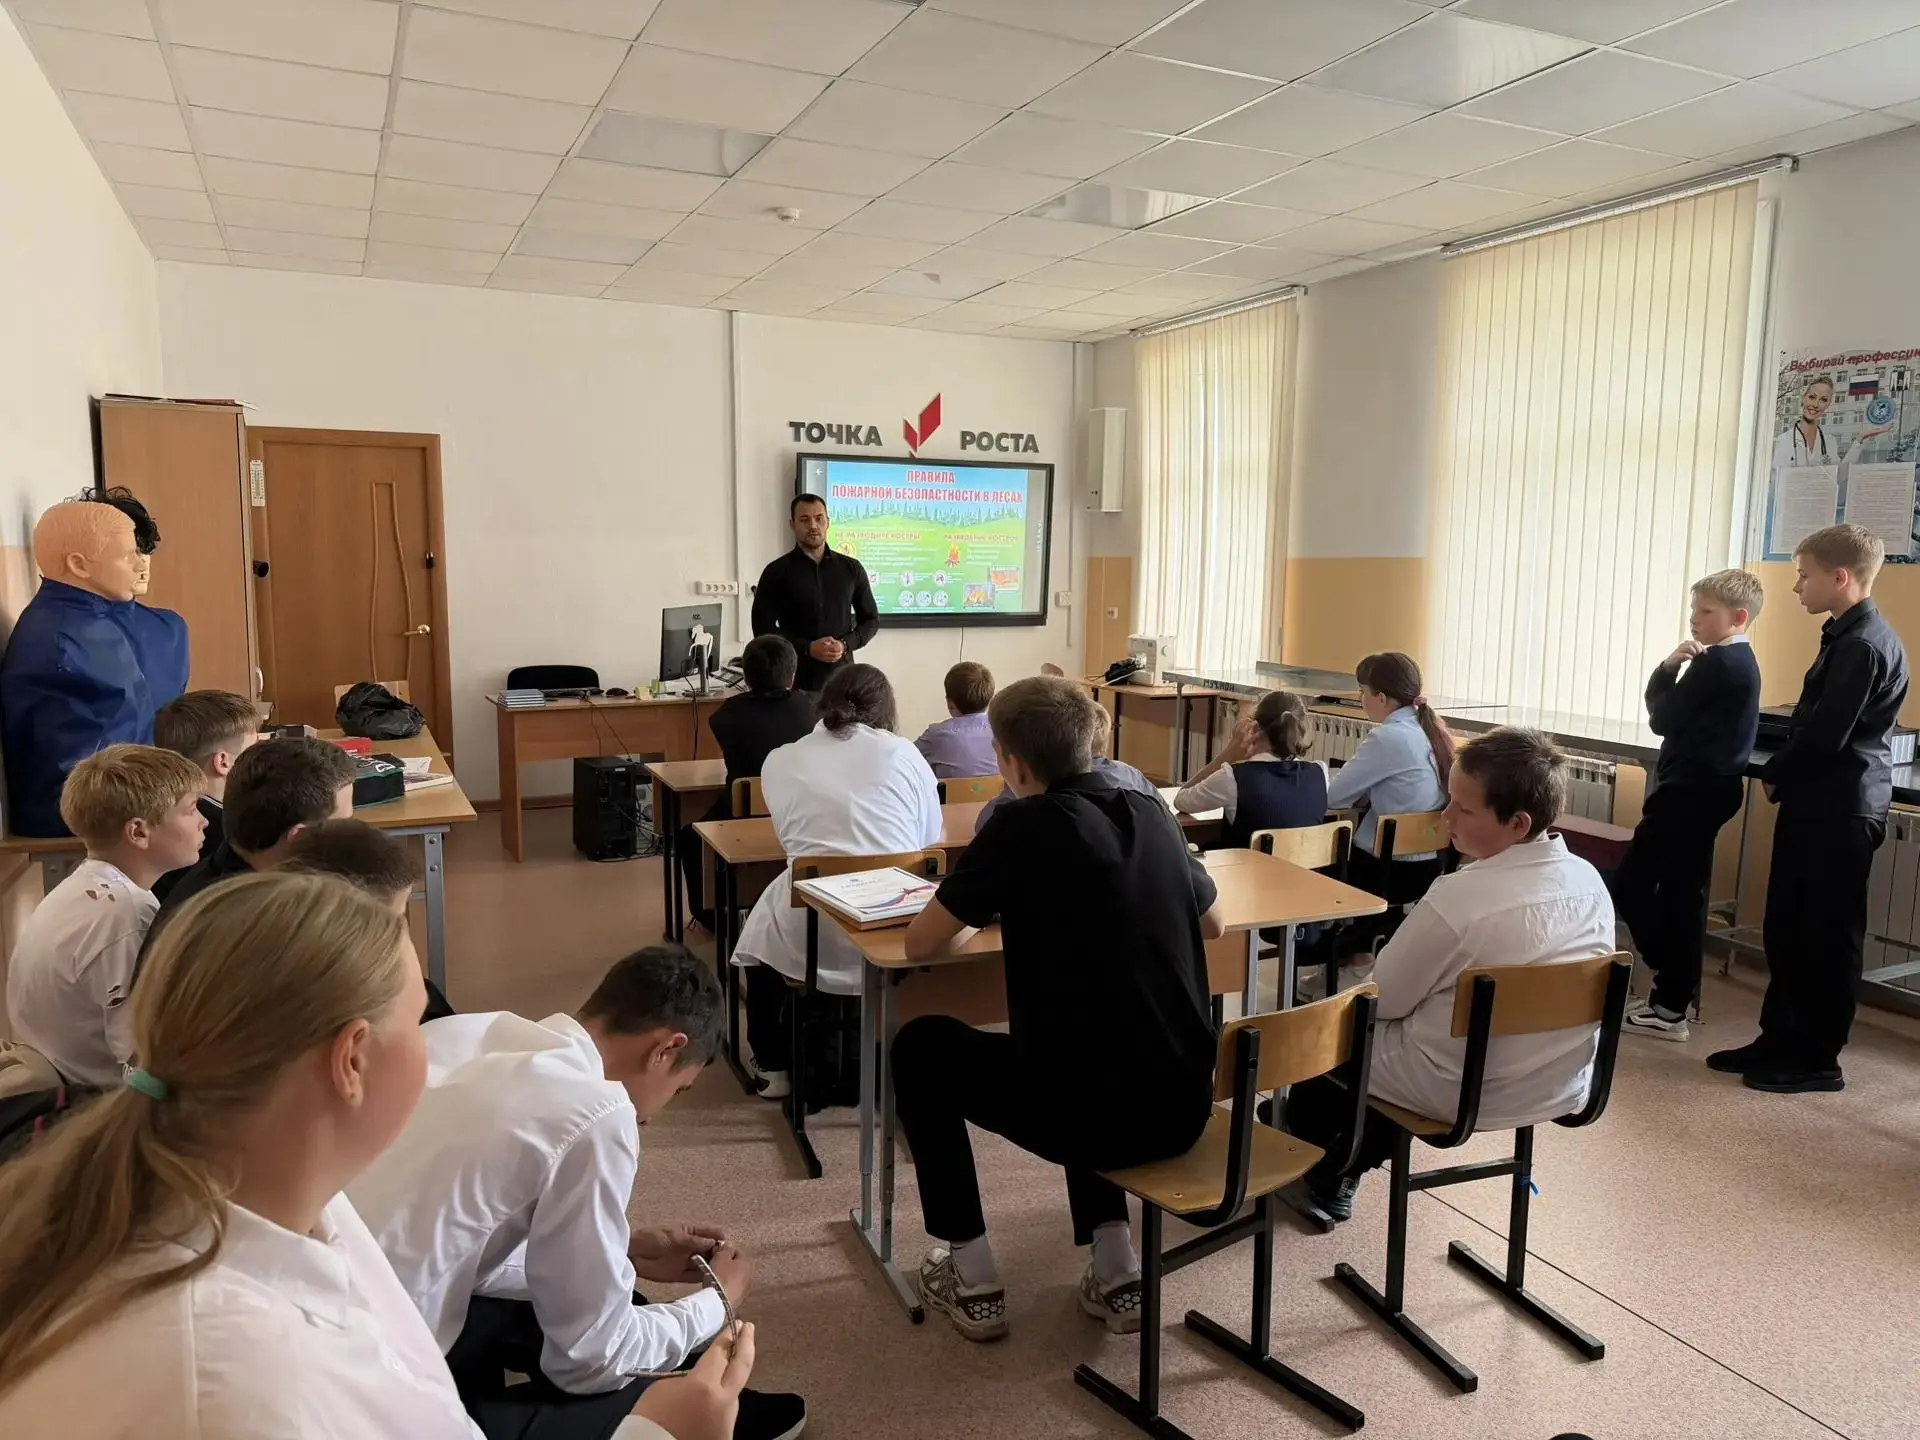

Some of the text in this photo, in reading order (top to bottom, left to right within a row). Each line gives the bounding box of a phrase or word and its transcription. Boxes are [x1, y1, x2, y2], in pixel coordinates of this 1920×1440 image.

[1790, 354, 1845, 371] Выбирай
[789, 421, 1040, 454] ТОЧКА РОСТА
[907, 470, 956, 484] ПРАВИЛА
[832, 484, 1023, 504] ПОЖАРНОЙ БЕЗОПАСТНОСТИ В ЛЕСАХ
